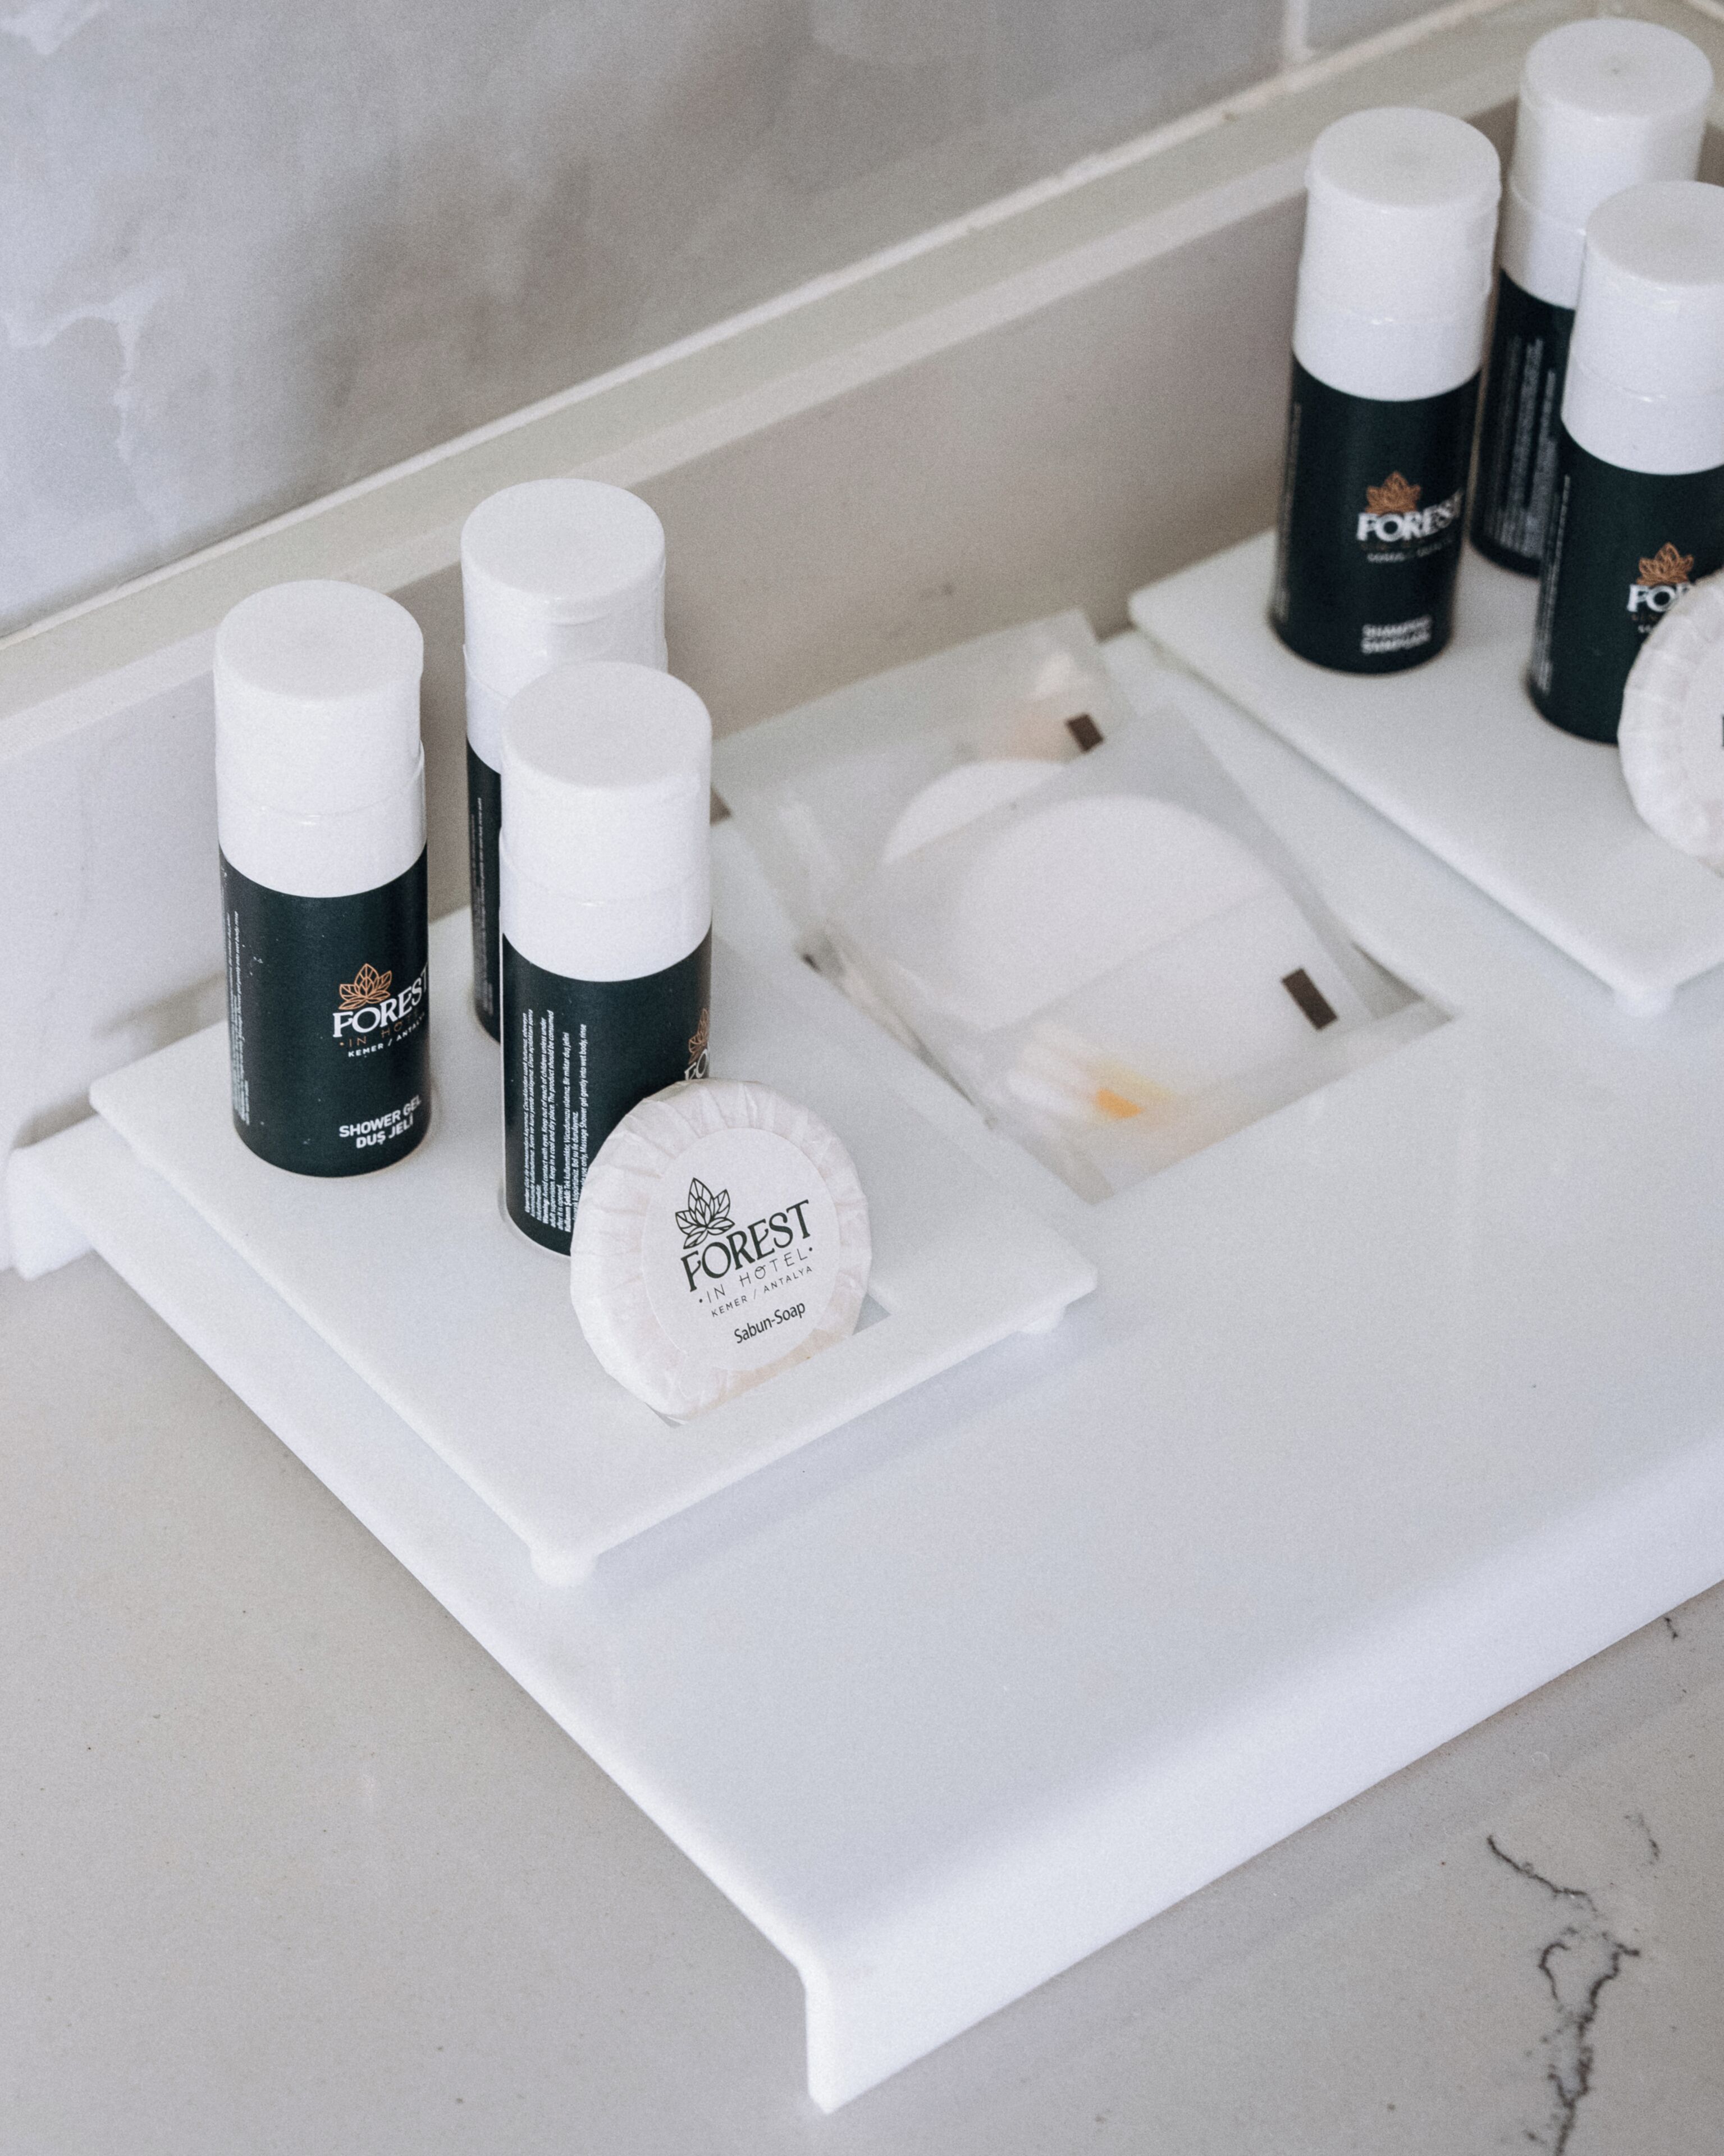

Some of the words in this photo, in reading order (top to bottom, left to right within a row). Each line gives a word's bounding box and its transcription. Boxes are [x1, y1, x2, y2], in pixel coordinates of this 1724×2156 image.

[333, 961, 428, 1038] FOREST
[381, 1010, 419, 1038] HOT
[348, 1043, 383, 1057] KEMER
[563, 1032, 571, 1047] jelini
[563, 1047, 571, 1058] duş
[579, 1039, 588, 1054] body,
[579, 1079, 588, 1097] gently
[579, 1097, 588, 1107] gel
[339, 1109, 401, 1138] SHOWER
[403, 1095, 421, 1116] GEL
[356, 1131, 386, 1149] DUŞ
[388, 1112, 413, 1139] JELİ
[580, 1129, 588, 1153] Massage
[680, 1199, 811, 1292] FOREST
[707, 1283, 725, 1303] IN
[739, 1248, 807, 1287] HOTEL
[711, 1295, 747, 1317] KEMER
[763, 1266, 812, 1292] ANTALYA
[734, 1303, 805, 1344] Sabun-Soap
